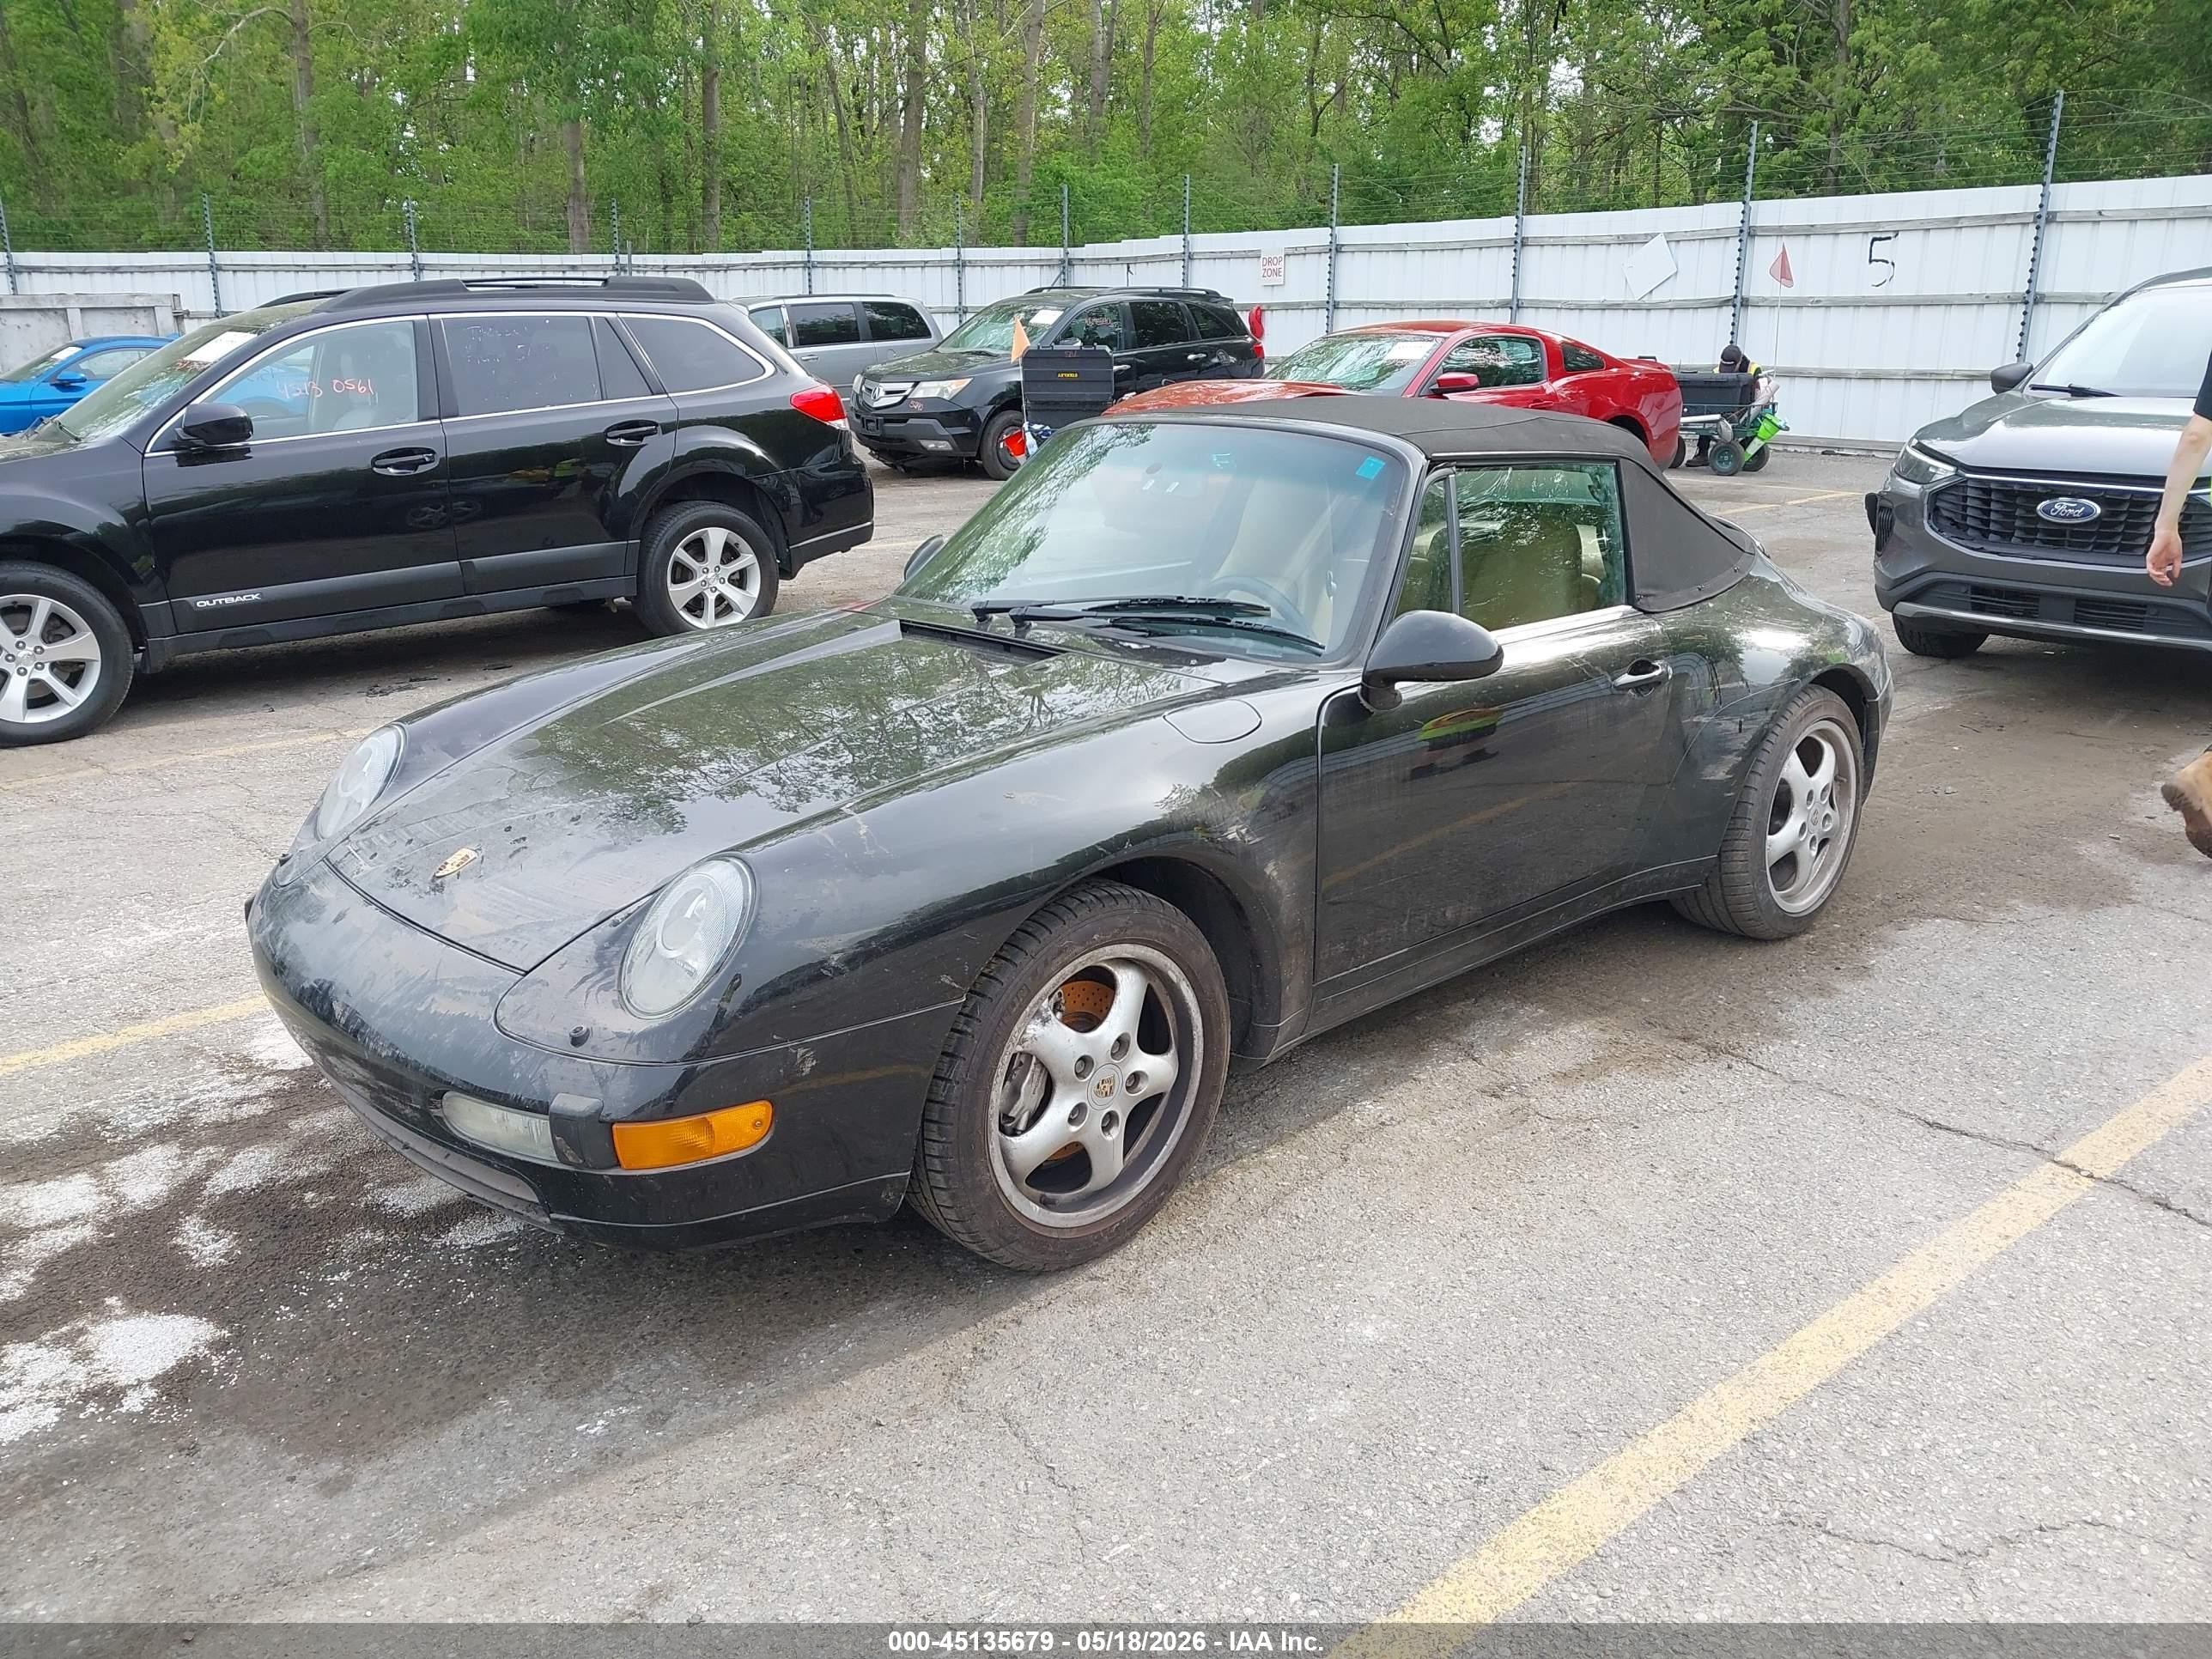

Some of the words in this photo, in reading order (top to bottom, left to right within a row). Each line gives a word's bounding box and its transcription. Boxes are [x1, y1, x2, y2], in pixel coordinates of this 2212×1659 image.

[1262, 256, 1283, 267] DROP
[1869, 233, 1899, 288] 5
[1262, 267, 1283, 278] ZONE
[332, 379, 374, 395] 0561
[2051, 501, 2086, 517] Ford
[196, 592, 262, 608] OUTBACK
